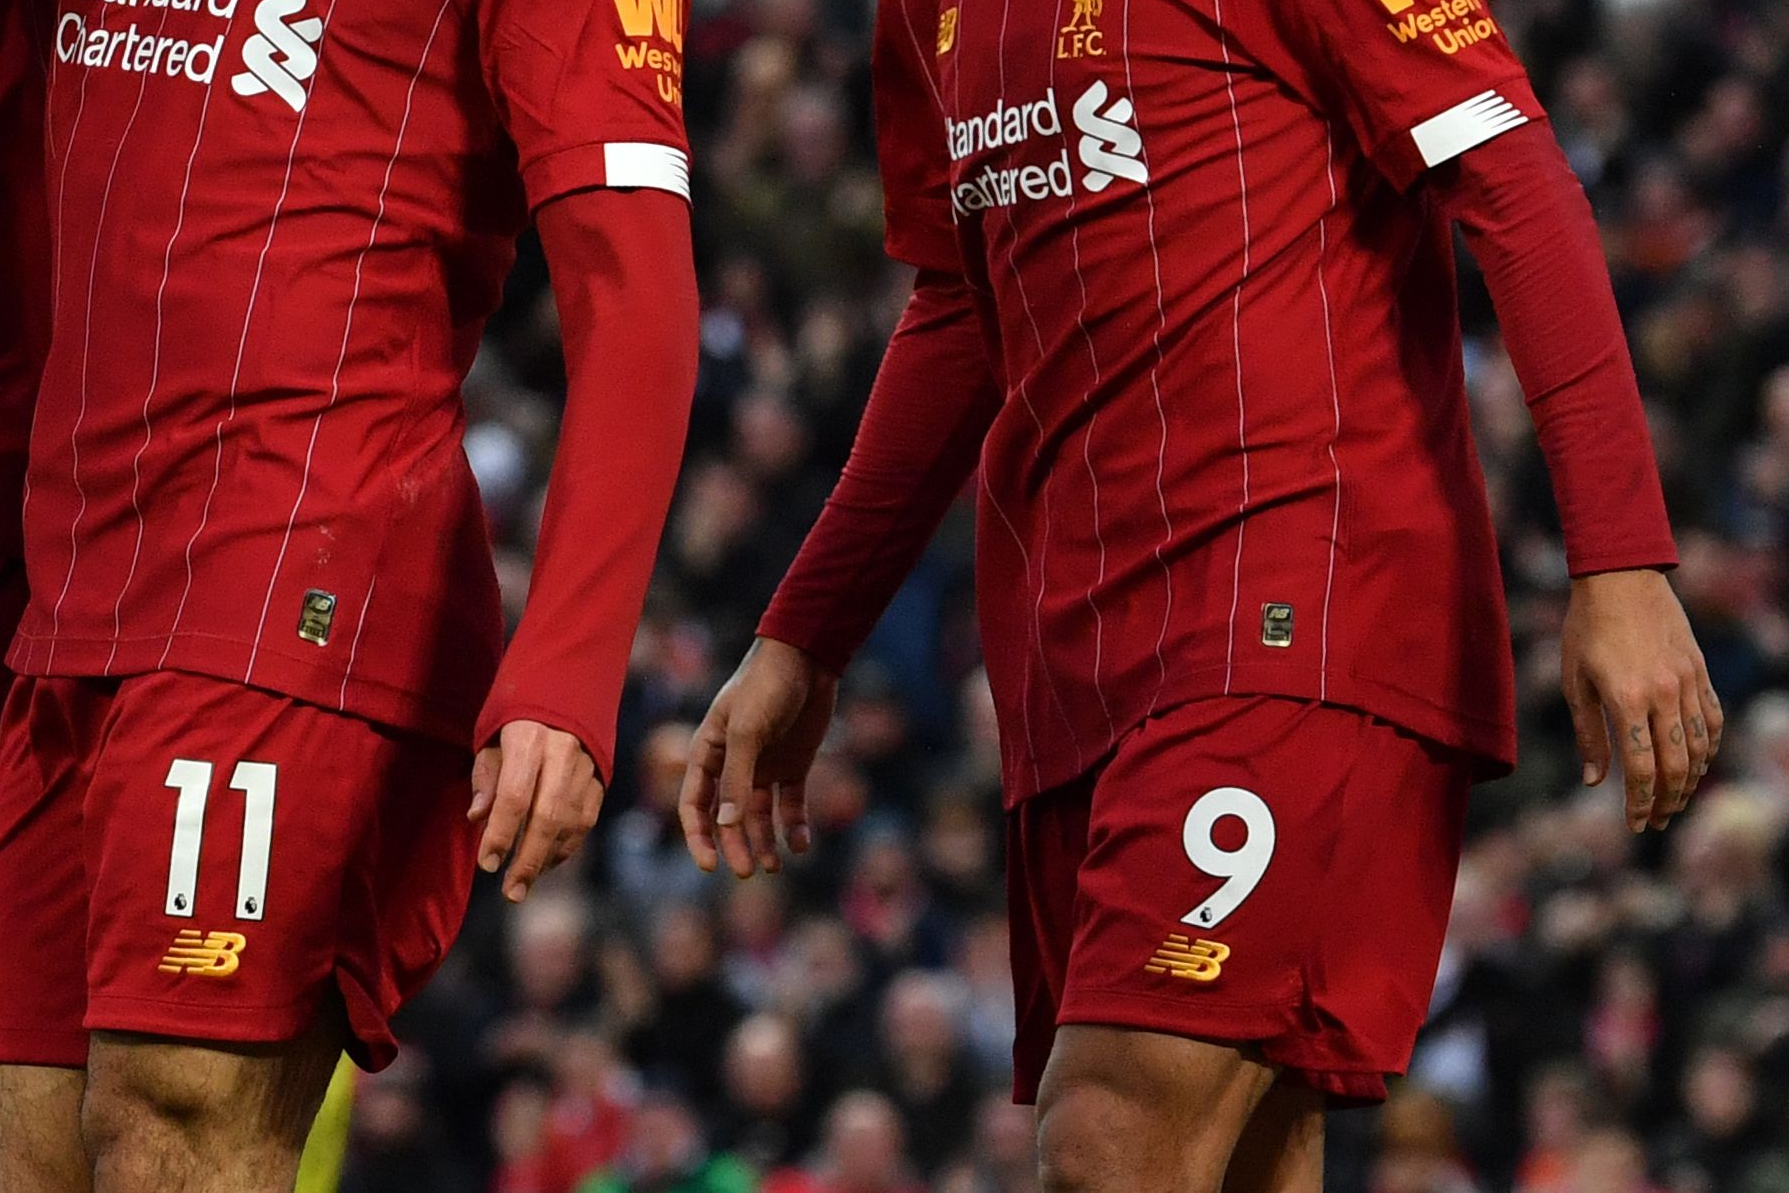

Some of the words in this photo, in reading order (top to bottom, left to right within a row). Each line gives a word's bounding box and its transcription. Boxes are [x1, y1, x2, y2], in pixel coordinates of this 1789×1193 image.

[56, 12, 225, 85] Chartered
[165, 758, 277, 920] 11
[1180, 786, 1276, 929] 9
